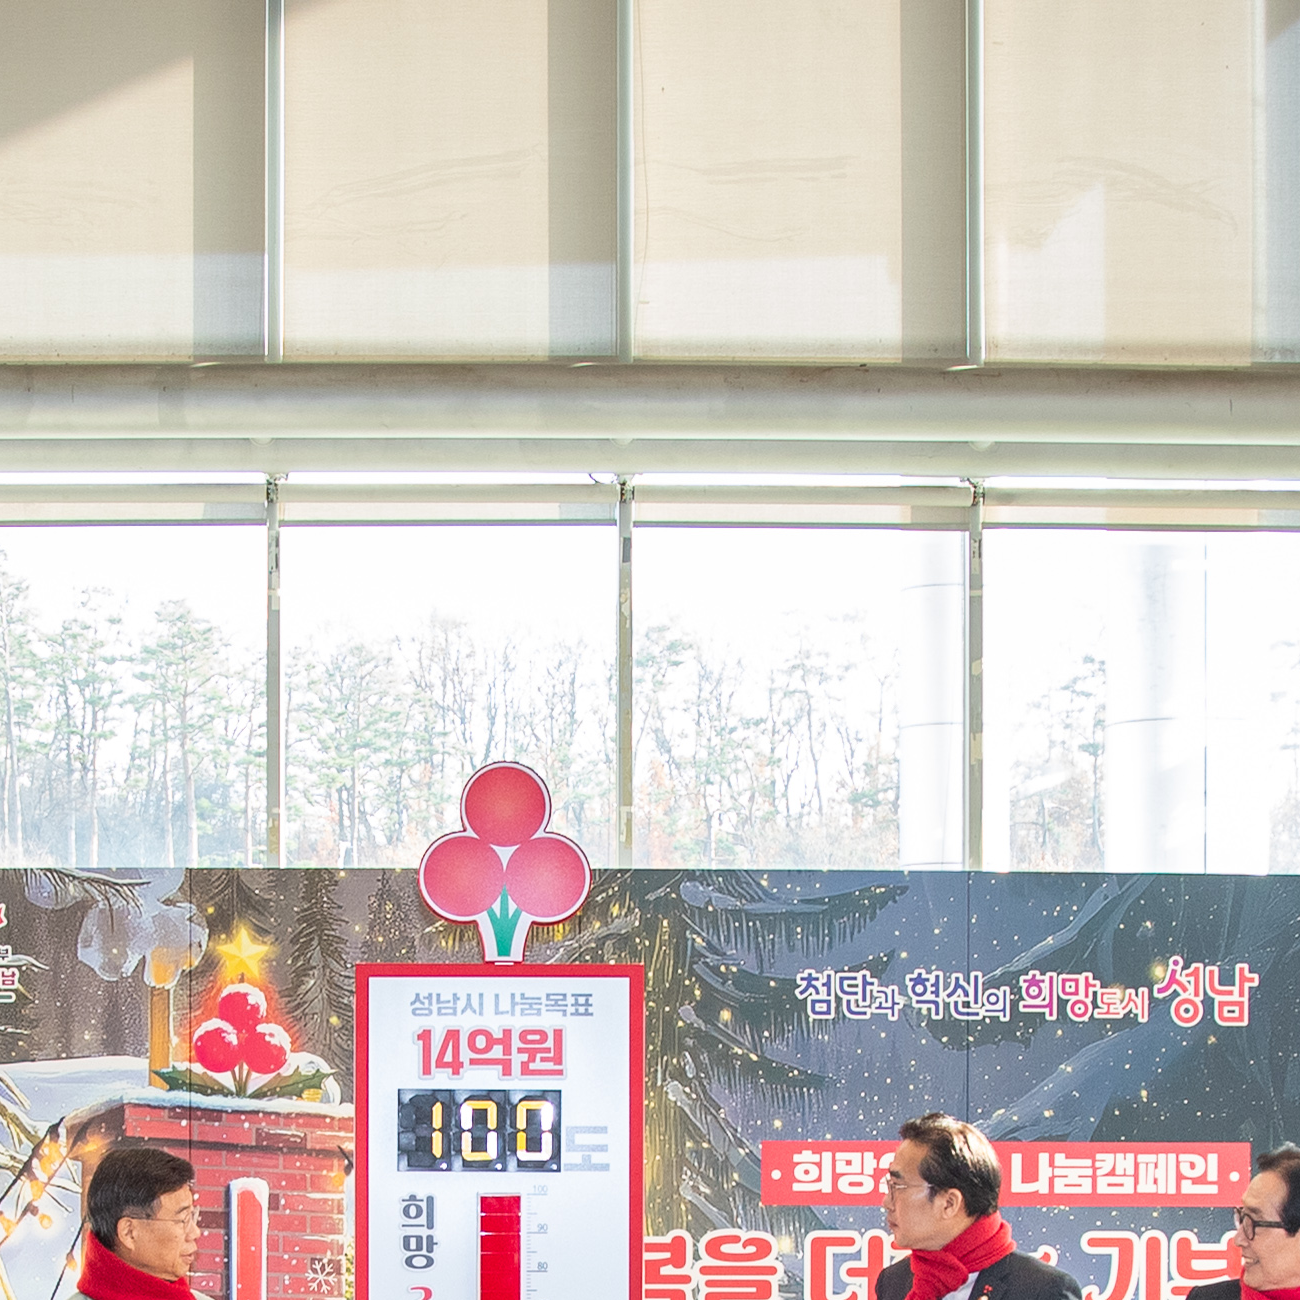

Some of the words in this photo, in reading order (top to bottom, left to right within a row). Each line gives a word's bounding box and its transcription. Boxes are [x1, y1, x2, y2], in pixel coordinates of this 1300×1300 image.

[410, 992, 484, 1017] 성남시
[495, 992, 594, 1017] 나눔목표
[798, 970, 900, 1017] 첨단과
[906, 969, 1009, 1018] 혁신의
[1019, 970, 1149, 1020] 희망도시
[1156, 958, 1259, 1026] 성남
[416, 1028, 566, 1077] 14억원
[431, 1099, 554, 1162] 100
[563, 1125, 610, 1172] 도
[1011, 1153, 1219, 1196] 나눔캠페인
[401, 1194, 438, 1270] 희망
[537, 1224, 548, 1232] 90
[537, 1262, 548, 1270] 80
